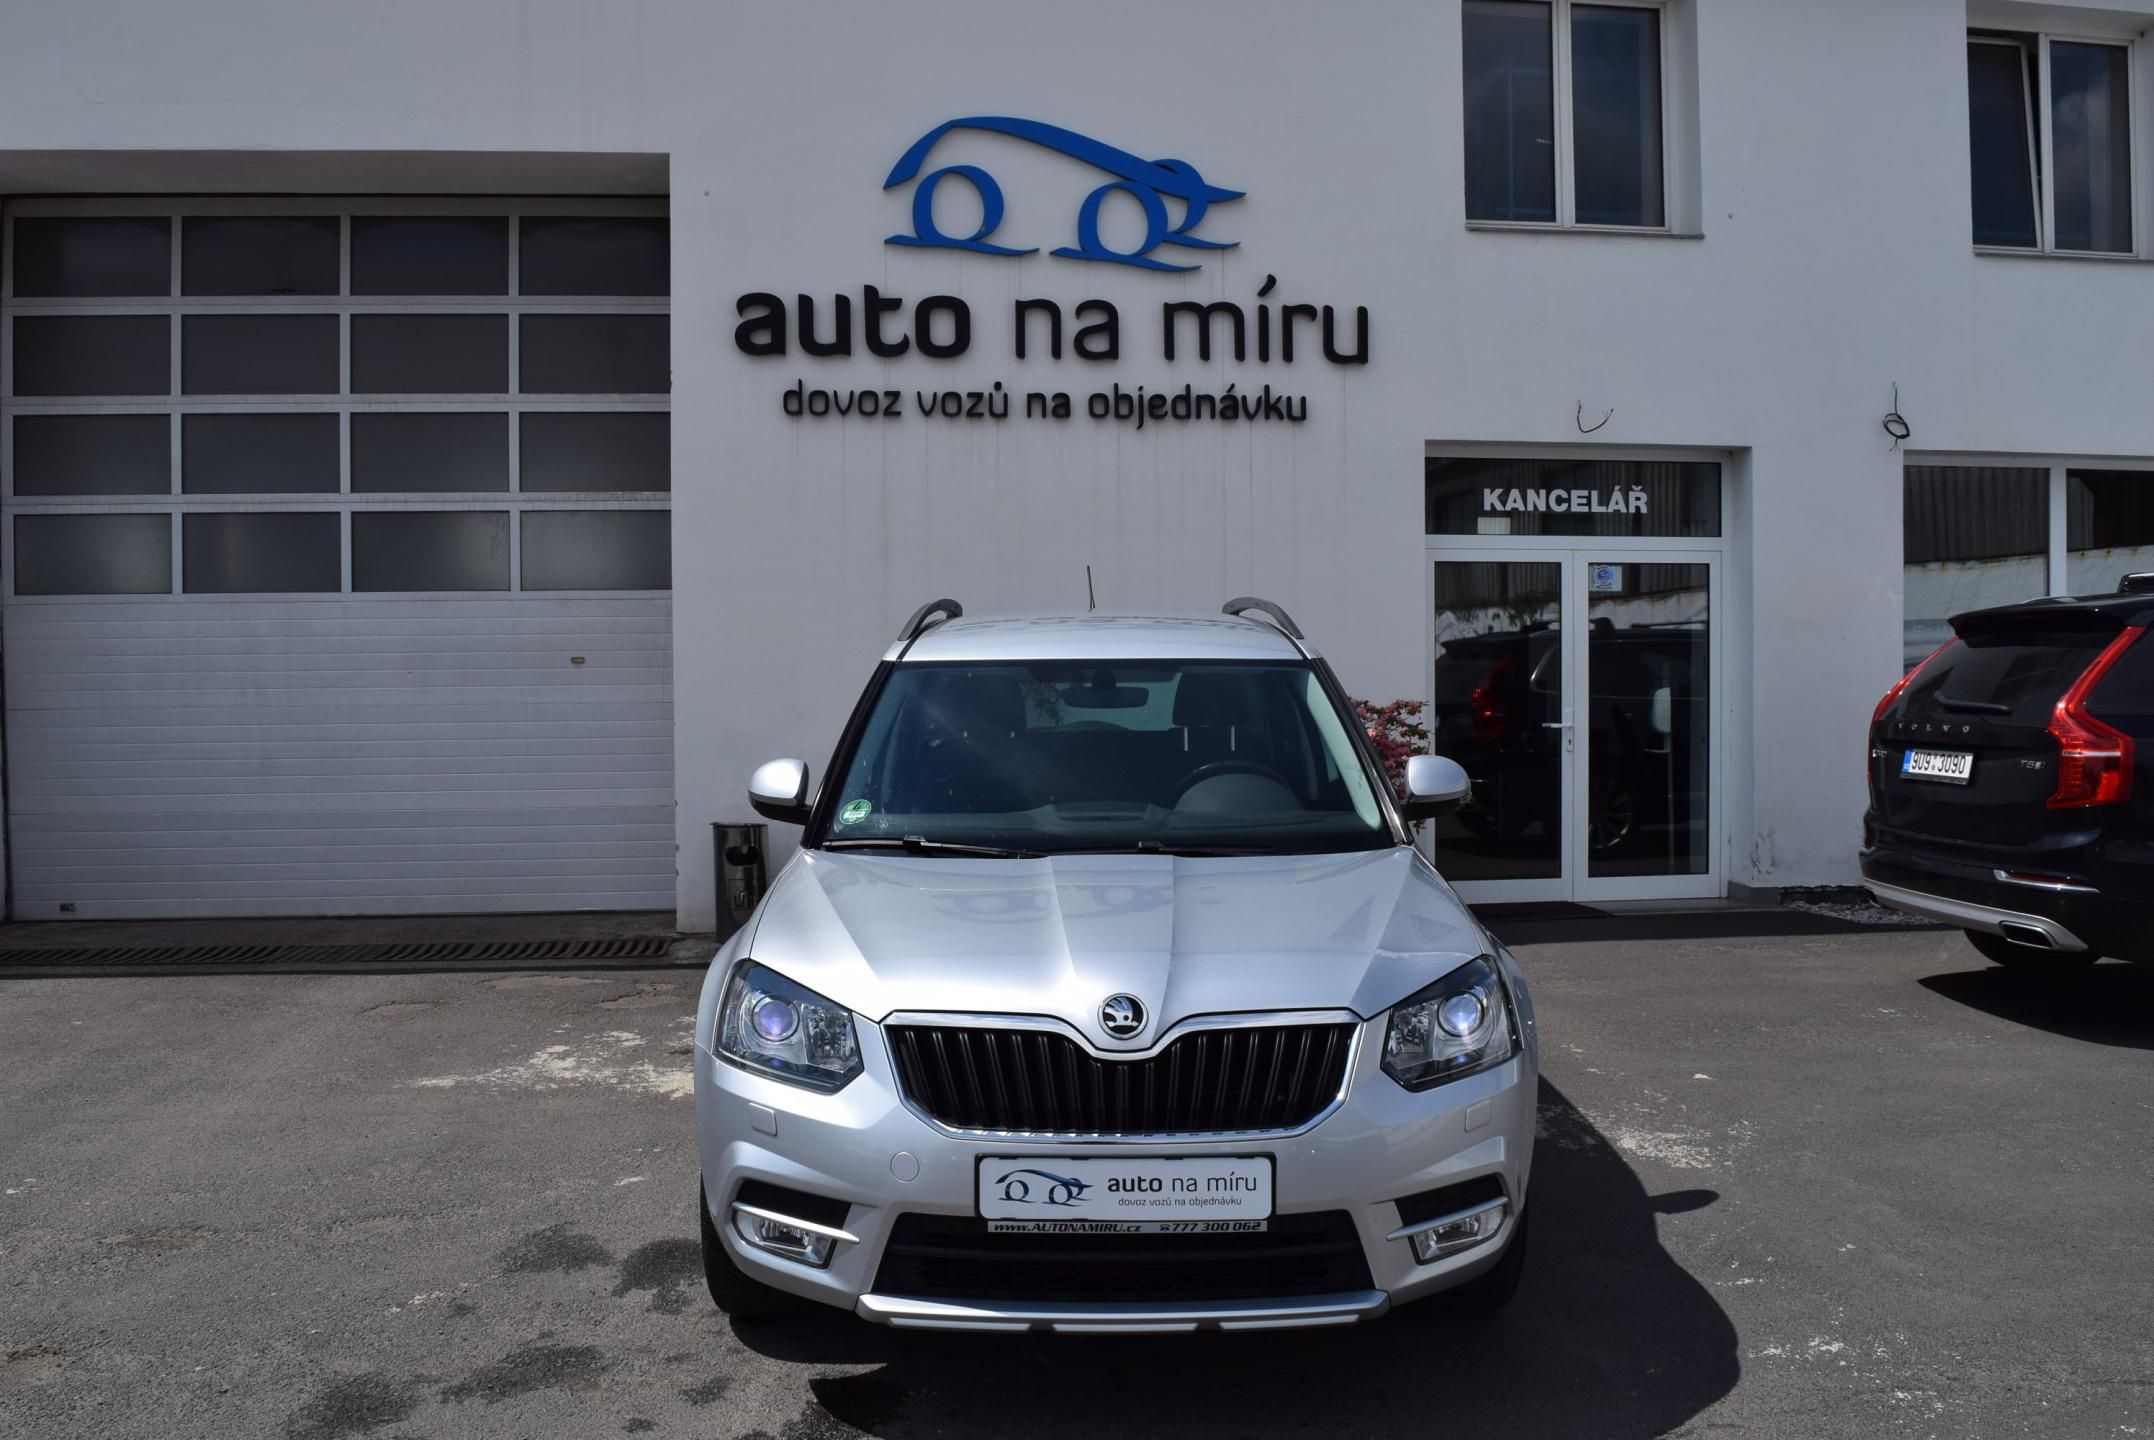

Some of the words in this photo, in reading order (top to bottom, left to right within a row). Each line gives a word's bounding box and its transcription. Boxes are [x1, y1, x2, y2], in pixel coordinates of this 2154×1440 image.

[734, 284, 972, 359] auto
[1014, 299, 1120, 361] na
[1163, 273, 1369, 365] míru
[782, 379, 903, 418] dovoz
[916, 381, 1009, 420] vozů
[1026, 391, 1072, 420] na
[1087, 383, 1308, 429] objednávku
[1482, 485, 1649, 514] KANCELÁŘ
[1911, 751, 1932, 771] 9U9
[1937, 753, 1967, 774] 3090
[1107, 1175, 1163, 1193] auto
[1171, 1177, 1198, 1193] na
[1207, 1170, 1257, 1192] míru
[1118, 1196, 1147, 1206] dovoz
[1149, 1196, 1172, 1206] vozů
[1174, 1198, 1186, 1206] na
[1189, 1195, 1242, 1208] objednávku
[994, 1223, 1142, 1233] www.AUTONAMIRU.cz
[1172, 1222, 1199, 1232] 777
[1201, 1222, 1230, 1232] 300
[1232, 1221, 1262, 1231] 062
